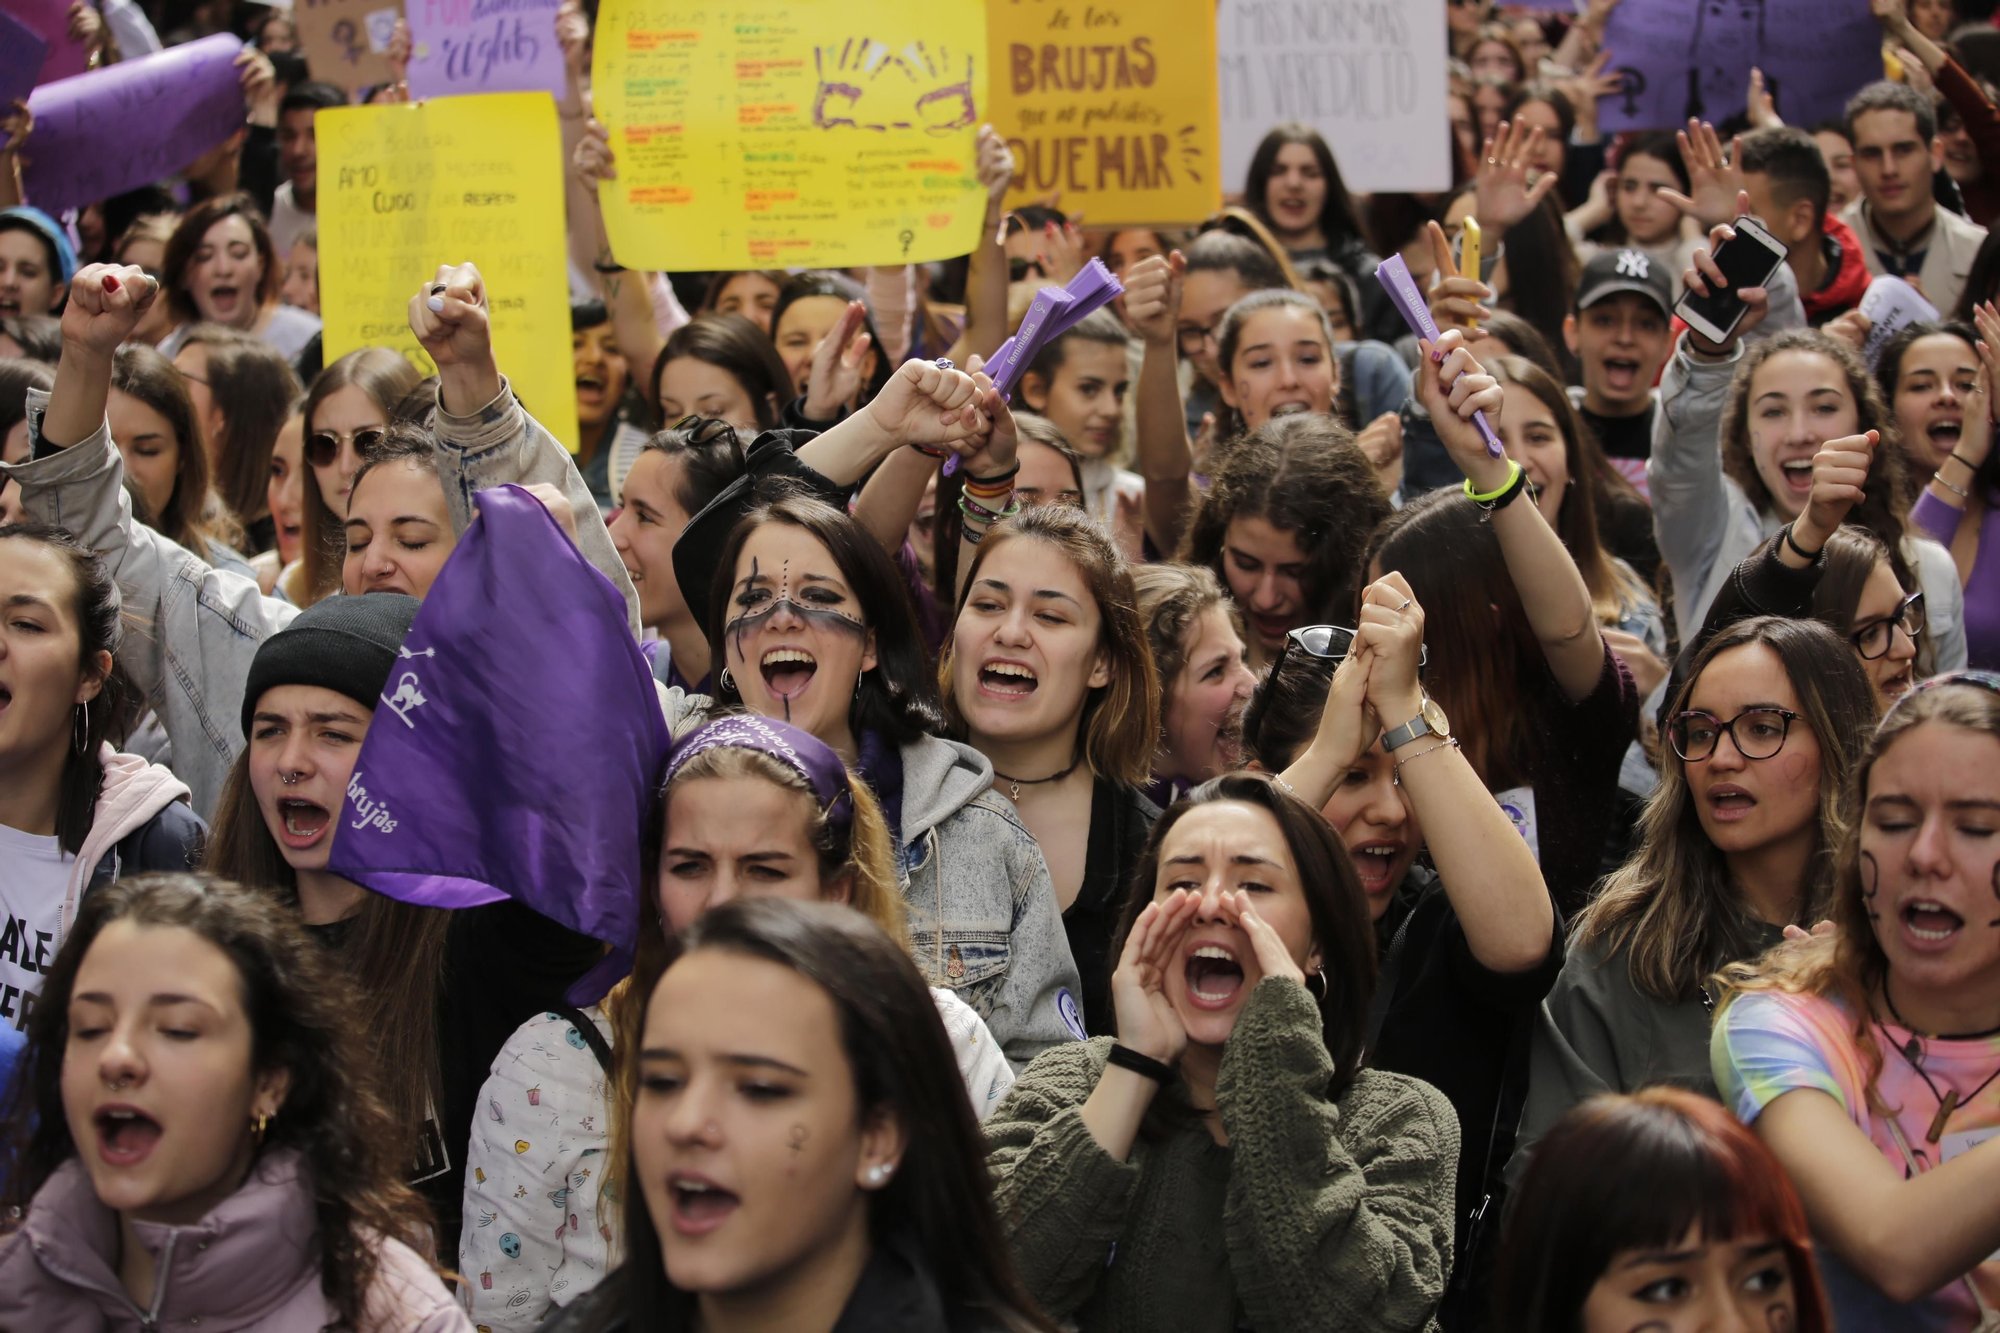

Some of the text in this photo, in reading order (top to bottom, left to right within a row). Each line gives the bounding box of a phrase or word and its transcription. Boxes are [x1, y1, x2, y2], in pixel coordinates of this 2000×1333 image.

[1009, 35, 1157, 97] BRUJAS
[338, 164, 379, 191] AMO
[1003, 133, 1175, 193] QUEMAR
[1404, 286, 1434, 335] feministas
[1006, 322, 1036, 366] feministas
[347, 771, 399, 834] brujas
[0, 910, 54, 976] ALE
[0, 982, 42, 1032] ER
